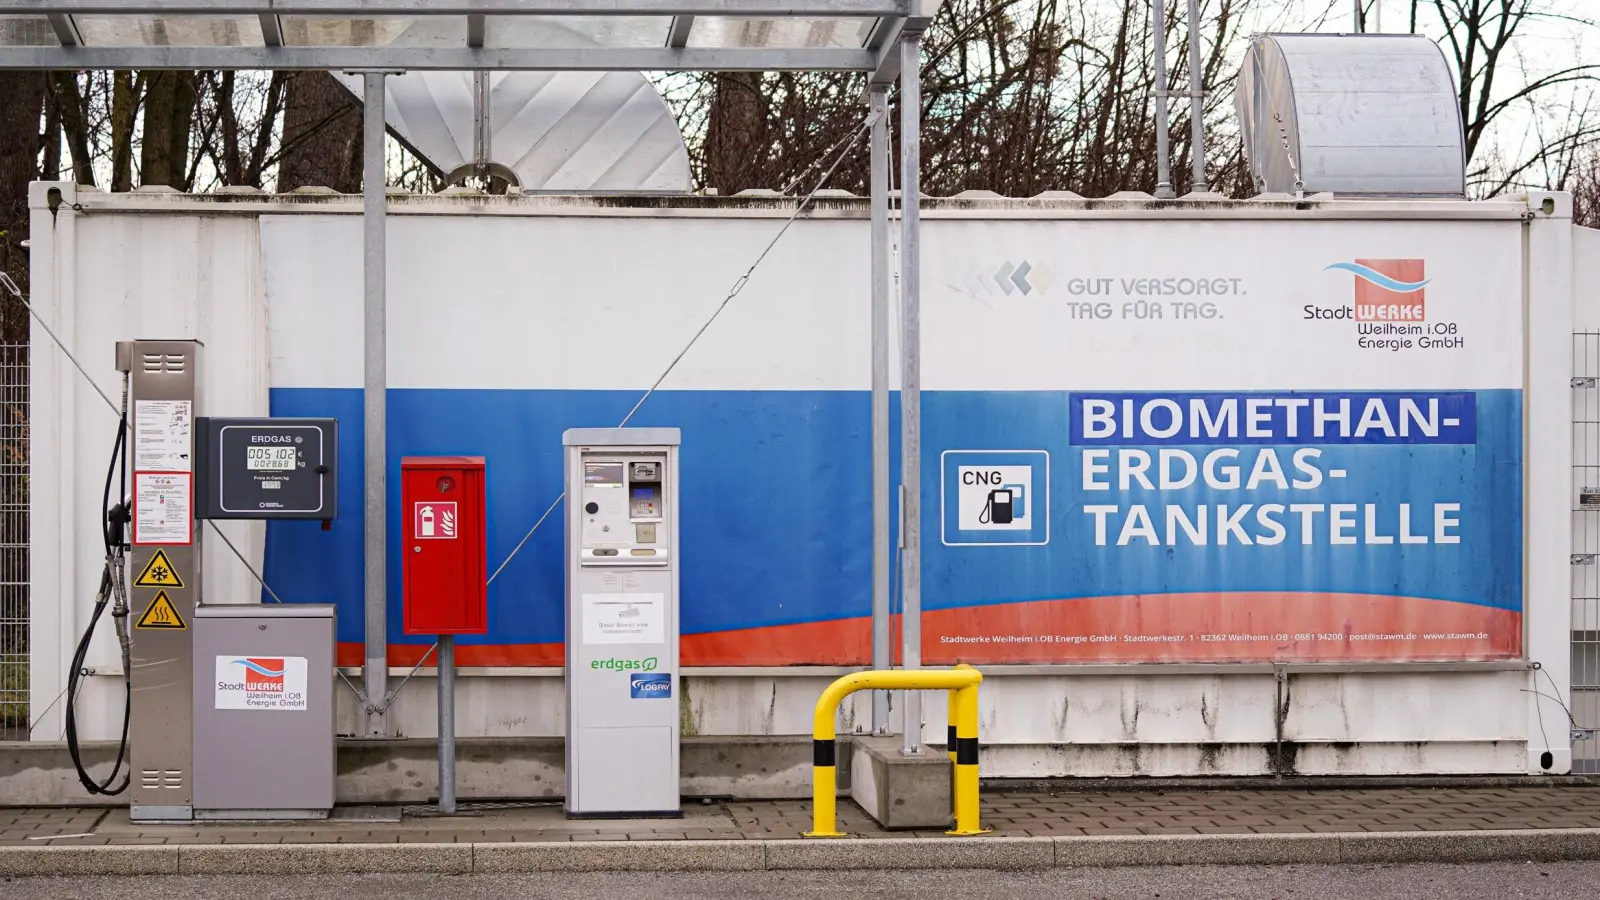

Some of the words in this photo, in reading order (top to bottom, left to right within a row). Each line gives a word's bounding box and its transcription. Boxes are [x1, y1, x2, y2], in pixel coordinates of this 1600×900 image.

[1067, 278, 1114, 295] GUT
[1120, 278, 1247, 295] VERSORGT.
[1066, 302, 1112, 319] TAG
[1122, 300, 1163, 319] FÜR
[1170, 302, 1224, 319] TAG.
[1357, 323, 1423, 335] Weilheim
[1358, 337, 1413, 352] Energie
[1418, 336, 1464, 349] GmbH
[1082, 397, 1460, 439] BIOMETHAN-
[251, 435, 291, 443] ERDGAS
[297, 460, 306, 468] kg
[1082, 447, 1347, 490] ERDGAS-
[963, 471, 1002, 485] CNG
[1083, 503, 1461, 546] TANKSTELLE
[940, 635, 990, 643] Stadtwerke
[992, 635, 1033, 643] Weilheim
[1034, 635, 1053, 643] i.OB
[1055, 635, 1087, 644] Energie
[1089, 634, 1117, 642] GmbH
[1123, 634, 1187, 642] Stadtwerkestr.
[1189, 634, 1194, 642] 1
[1201, 634, 1226, 642] 82362
[1228, 633, 1269, 641] Weilheim
[1270, 633, 1289, 641] i.OB
[1294, 633, 1315, 641] 0881
[1317, 633, 1343, 641] 94200
[1349, 632, 1417, 643] post@stawm.de
[1423, 631, 1488, 640] www.stawm.de
[591, 657, 640, 671] erdgas
[246, 699, 277, 707] Energie
